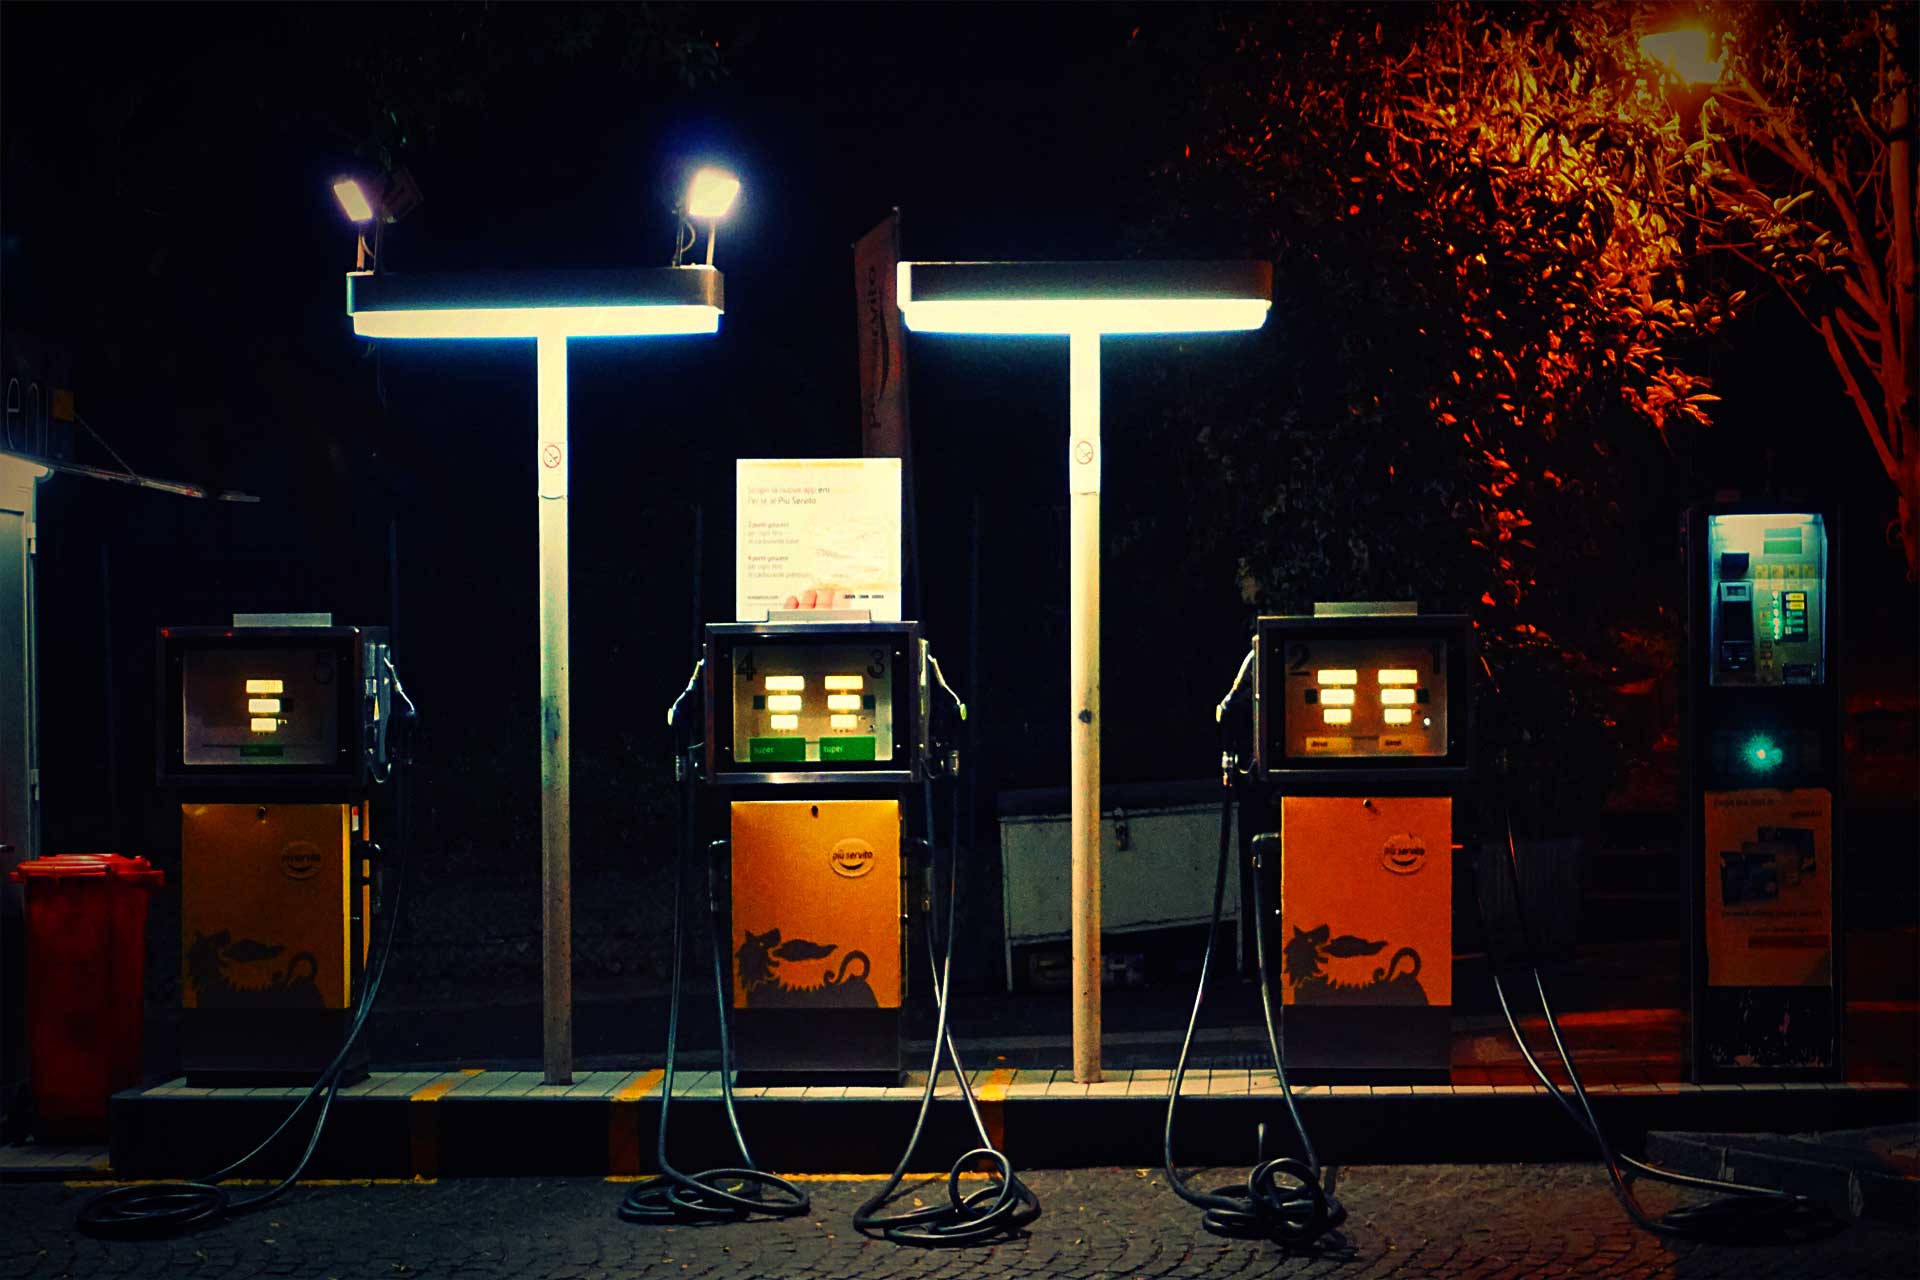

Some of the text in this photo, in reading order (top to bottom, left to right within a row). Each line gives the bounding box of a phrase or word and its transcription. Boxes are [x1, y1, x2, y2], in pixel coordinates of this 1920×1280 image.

[313, 653, 334, 684] 5
[737, 650, 756, 681] 4
[867, 649, 885, 678] 3
[1290, 643, 1311, 676] 2
[845, 849, 873, 860] servito
